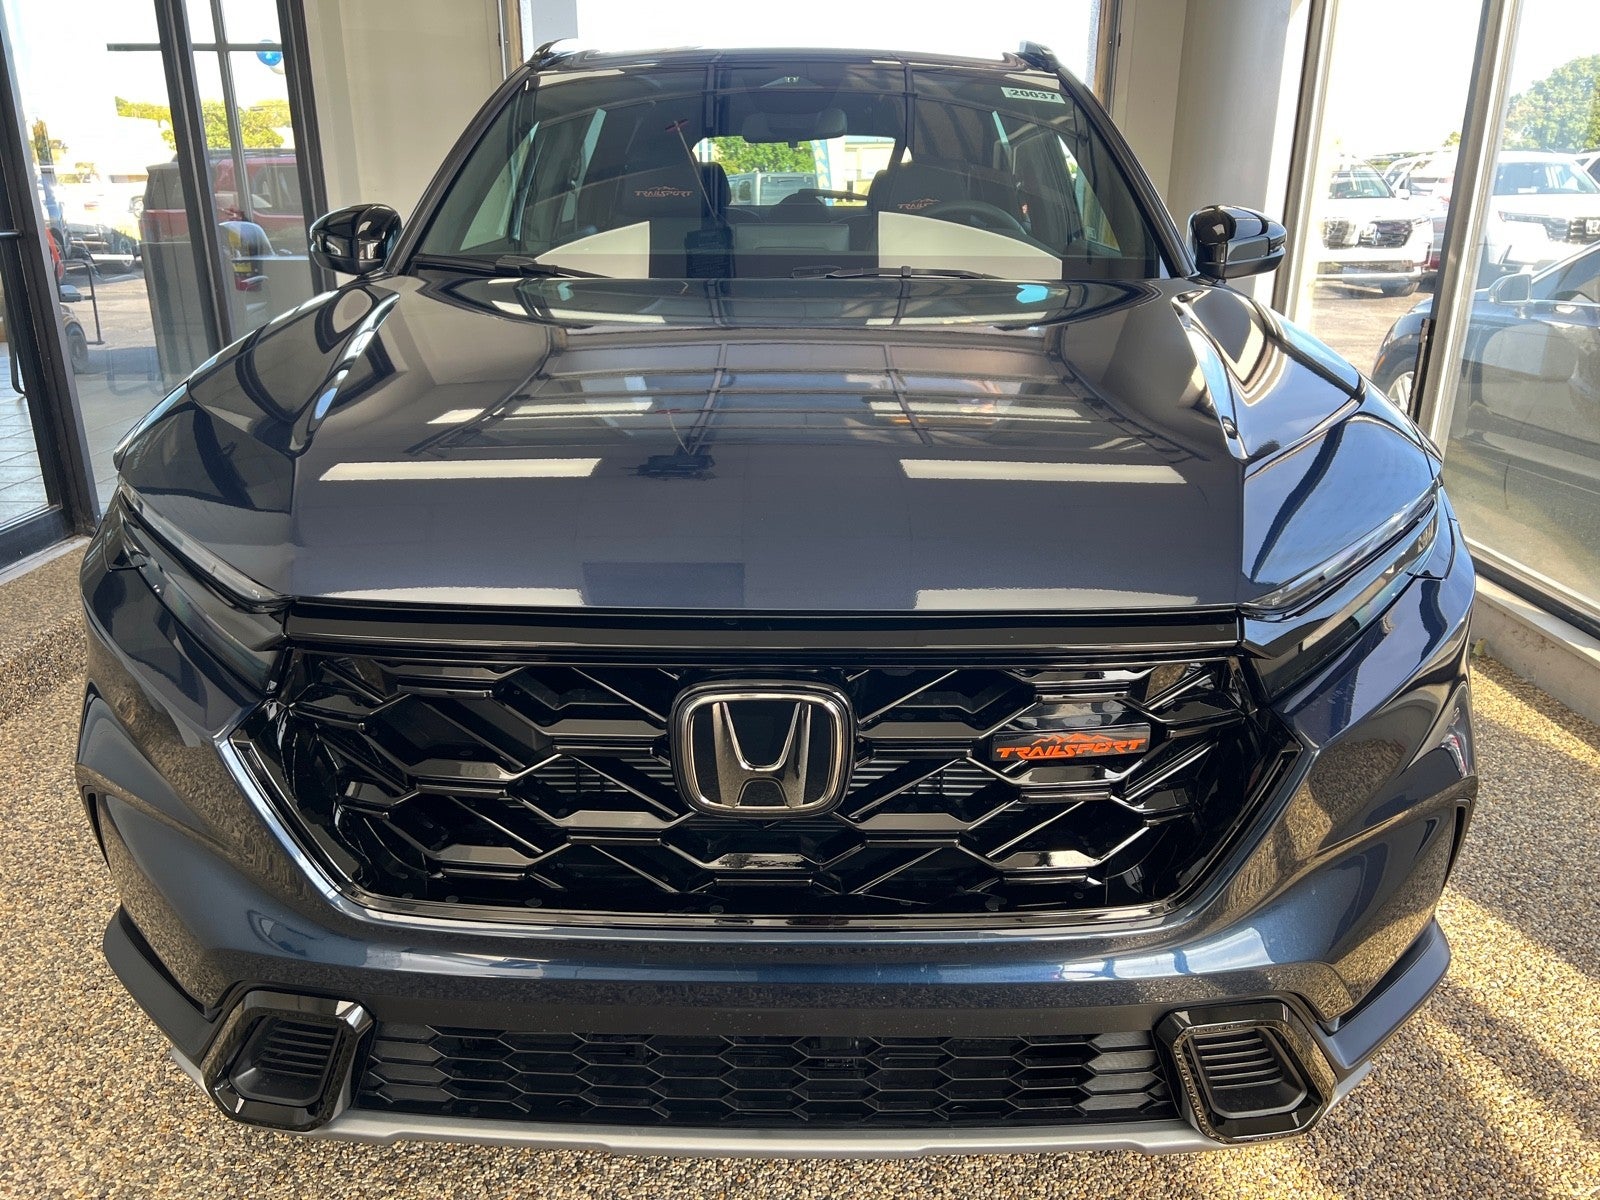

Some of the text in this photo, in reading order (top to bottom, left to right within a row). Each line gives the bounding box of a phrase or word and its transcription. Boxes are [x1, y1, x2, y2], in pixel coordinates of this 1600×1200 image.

[1010, 89, 1056, 100] 20037
[634, 190, 693, 198] TRAILSPORT
[997, 738, 1146, 760] TRAILSPORT
